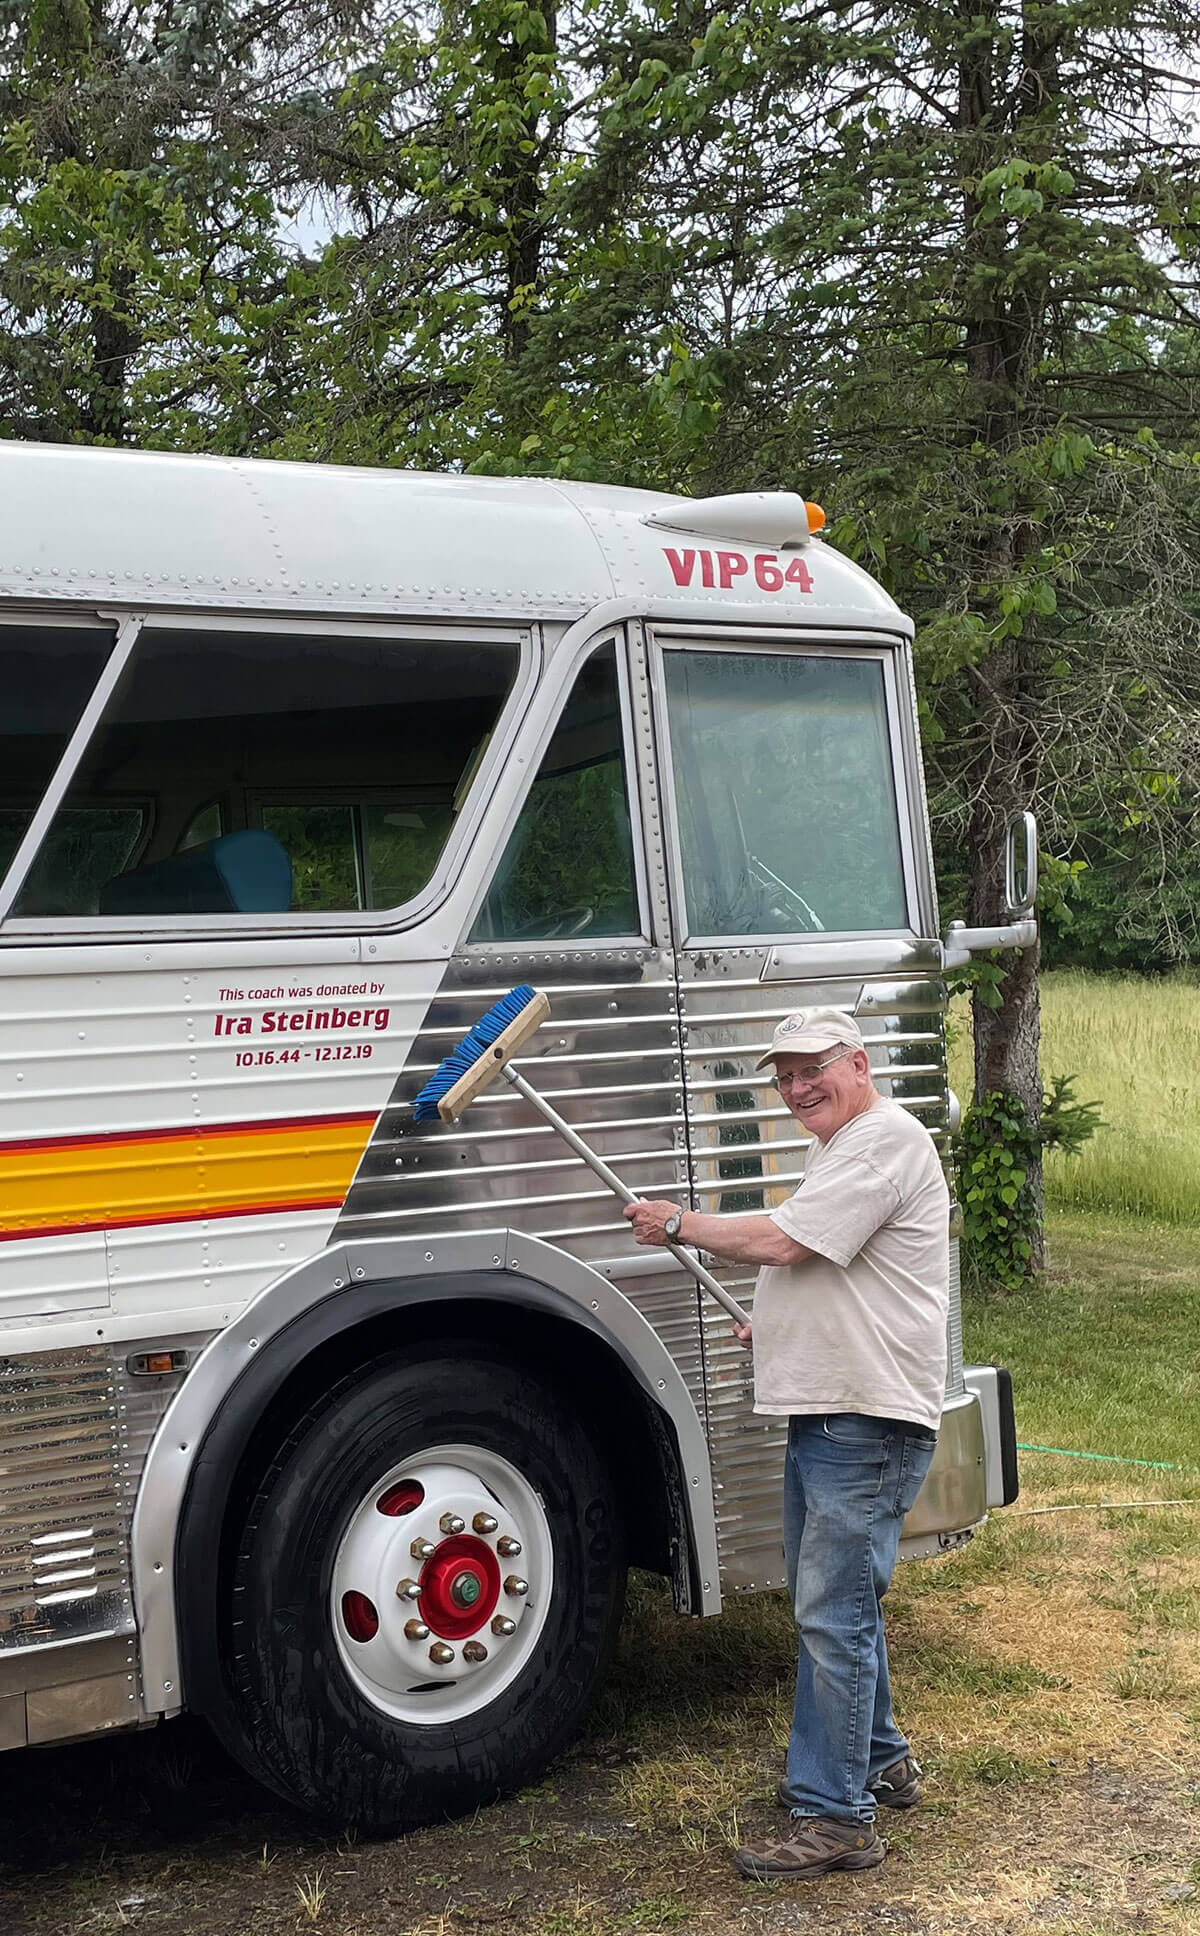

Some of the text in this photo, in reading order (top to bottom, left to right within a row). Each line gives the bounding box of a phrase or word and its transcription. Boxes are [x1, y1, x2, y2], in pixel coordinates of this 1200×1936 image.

[219, 982, 385, 1000] This coach was donated by
[214, 1007, 389, 1036] Ira Steinberg
[236, 1050, 300, 1066] 10.16.44
[315, 1044, 372, 1061] 12.12.19
